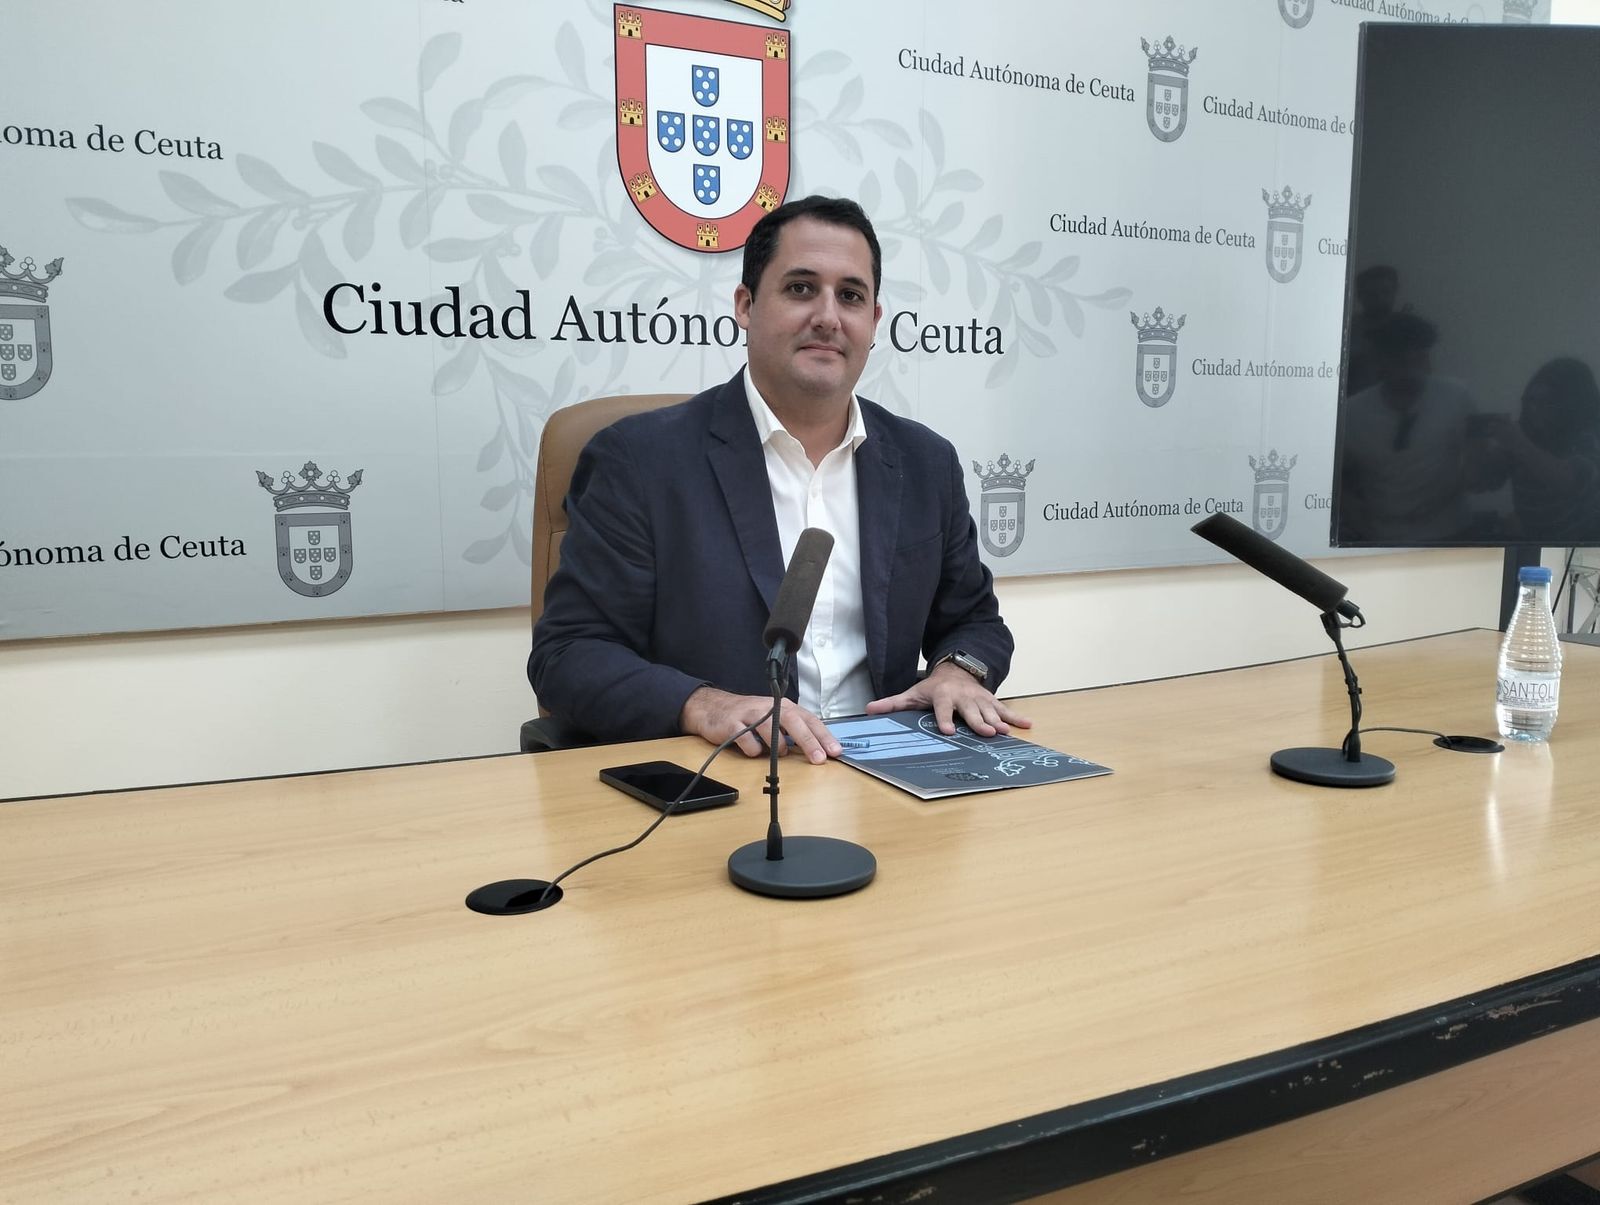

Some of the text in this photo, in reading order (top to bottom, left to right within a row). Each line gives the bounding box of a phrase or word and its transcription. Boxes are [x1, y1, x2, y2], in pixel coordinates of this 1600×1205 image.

[898, 48, 1135, 102] Ciudad Autónoma de Ceuta
[1203, 95, 1253, 120] Ciudad
[1256, 105, 1327, 132] Autónoma
[1330, 115, 1346, 135] de
[0, 124, 224, 160] oma de Ceuta
[1050, 213, 1256, 249] Ciudad Autónoma de Ceuta
[323, 282, 1004, 354] Ciudad Autóno Ceuta
[1192, 358, 1241, 376] Ciudad
[1244, 360, 1314, 378] Autónoma
[1317, 361, 1333, 378] de
[1043, 497, 1243, 521] Ciudad Autónoma de Ceuta
[113, 535, 151, 561] de
[159, 535, 247, 559] Ceuta
